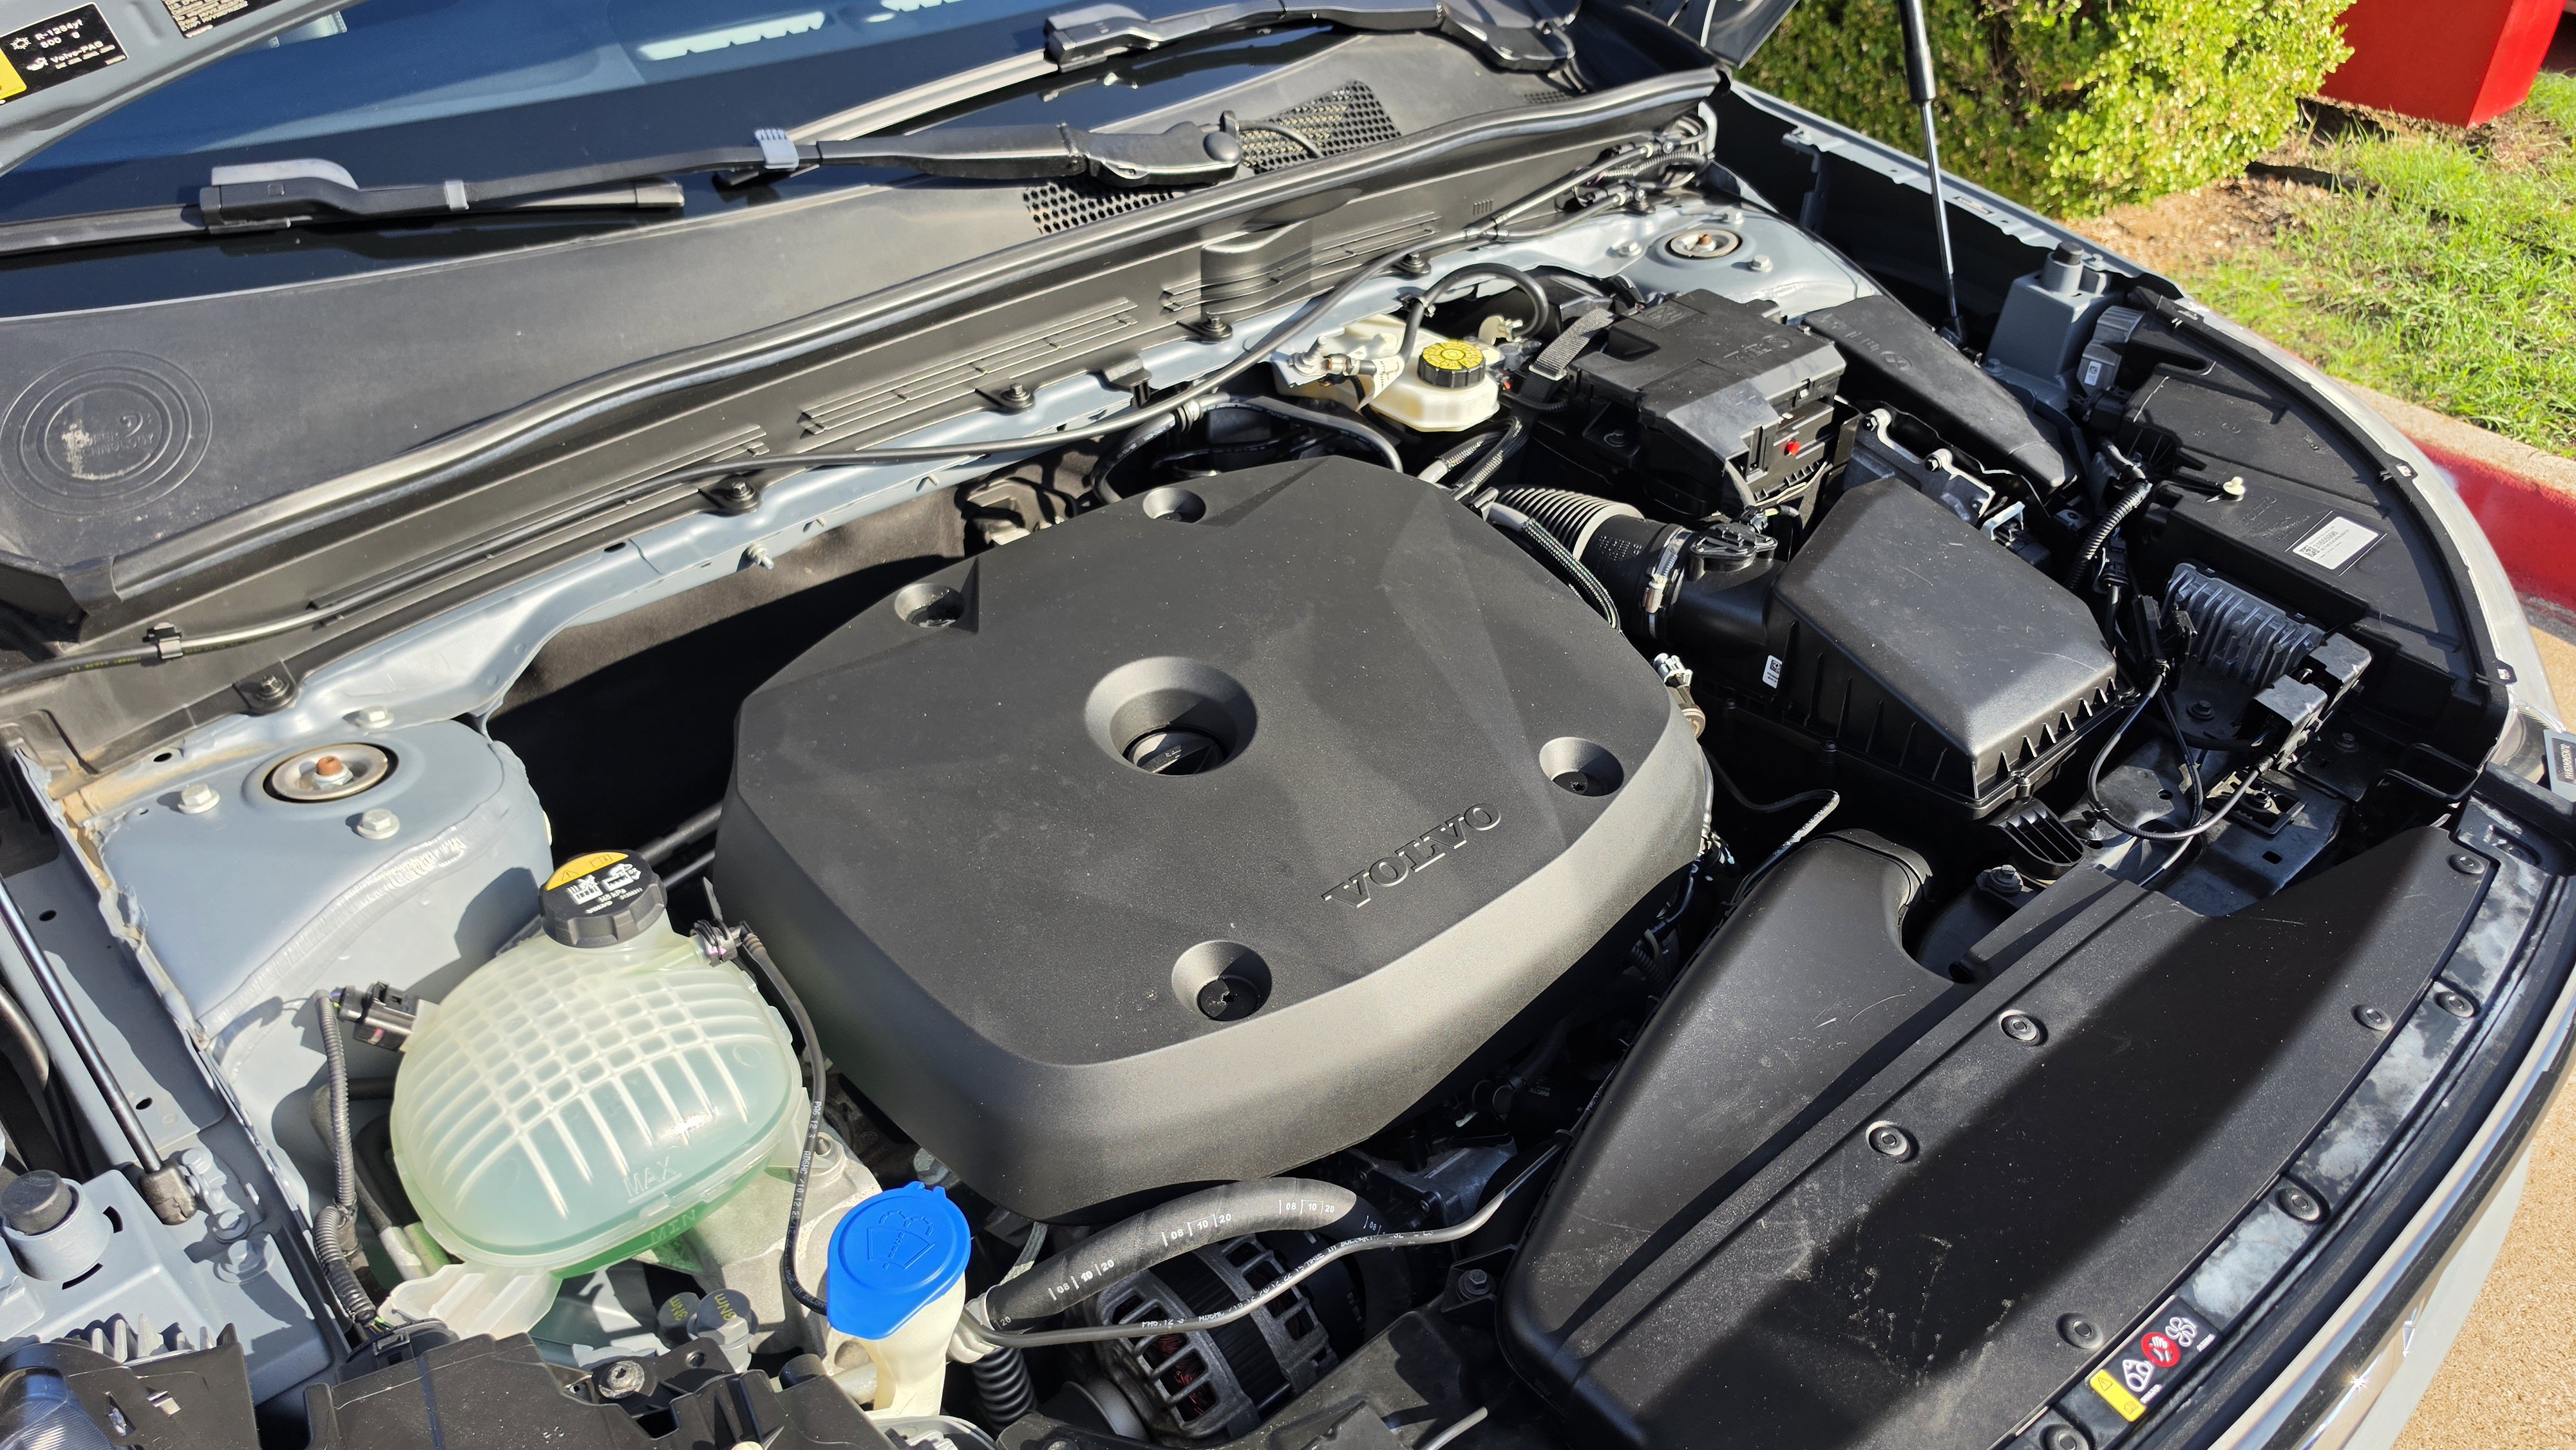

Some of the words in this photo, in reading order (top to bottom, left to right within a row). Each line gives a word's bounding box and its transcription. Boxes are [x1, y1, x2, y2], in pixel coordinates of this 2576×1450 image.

[1321, 802, 1501, 908] VOLVO
[623, 1156, 677, 1198] MAX
[1285, 1202, 1296, 1210] 08
[1308, 1203, 1317, 1211] 10
[1325, 1204, 1335, 1213] 20
[650, 1209, 696, 1243] MIN
[1171, 1229, 1184, 1239] 08
[1197, 1219, 1209, 1229] 10
[1219, 1213, 1231, 1223] 20
[1057, 1283, 1070, 1294] 08
[1081, 1270, 1094, 1283] 10
[1101, 1259, 1115, 1272] 20
[714, 1293, 737, 1321] 3Nm
[1000, 1316, 1011, 1326] 20
